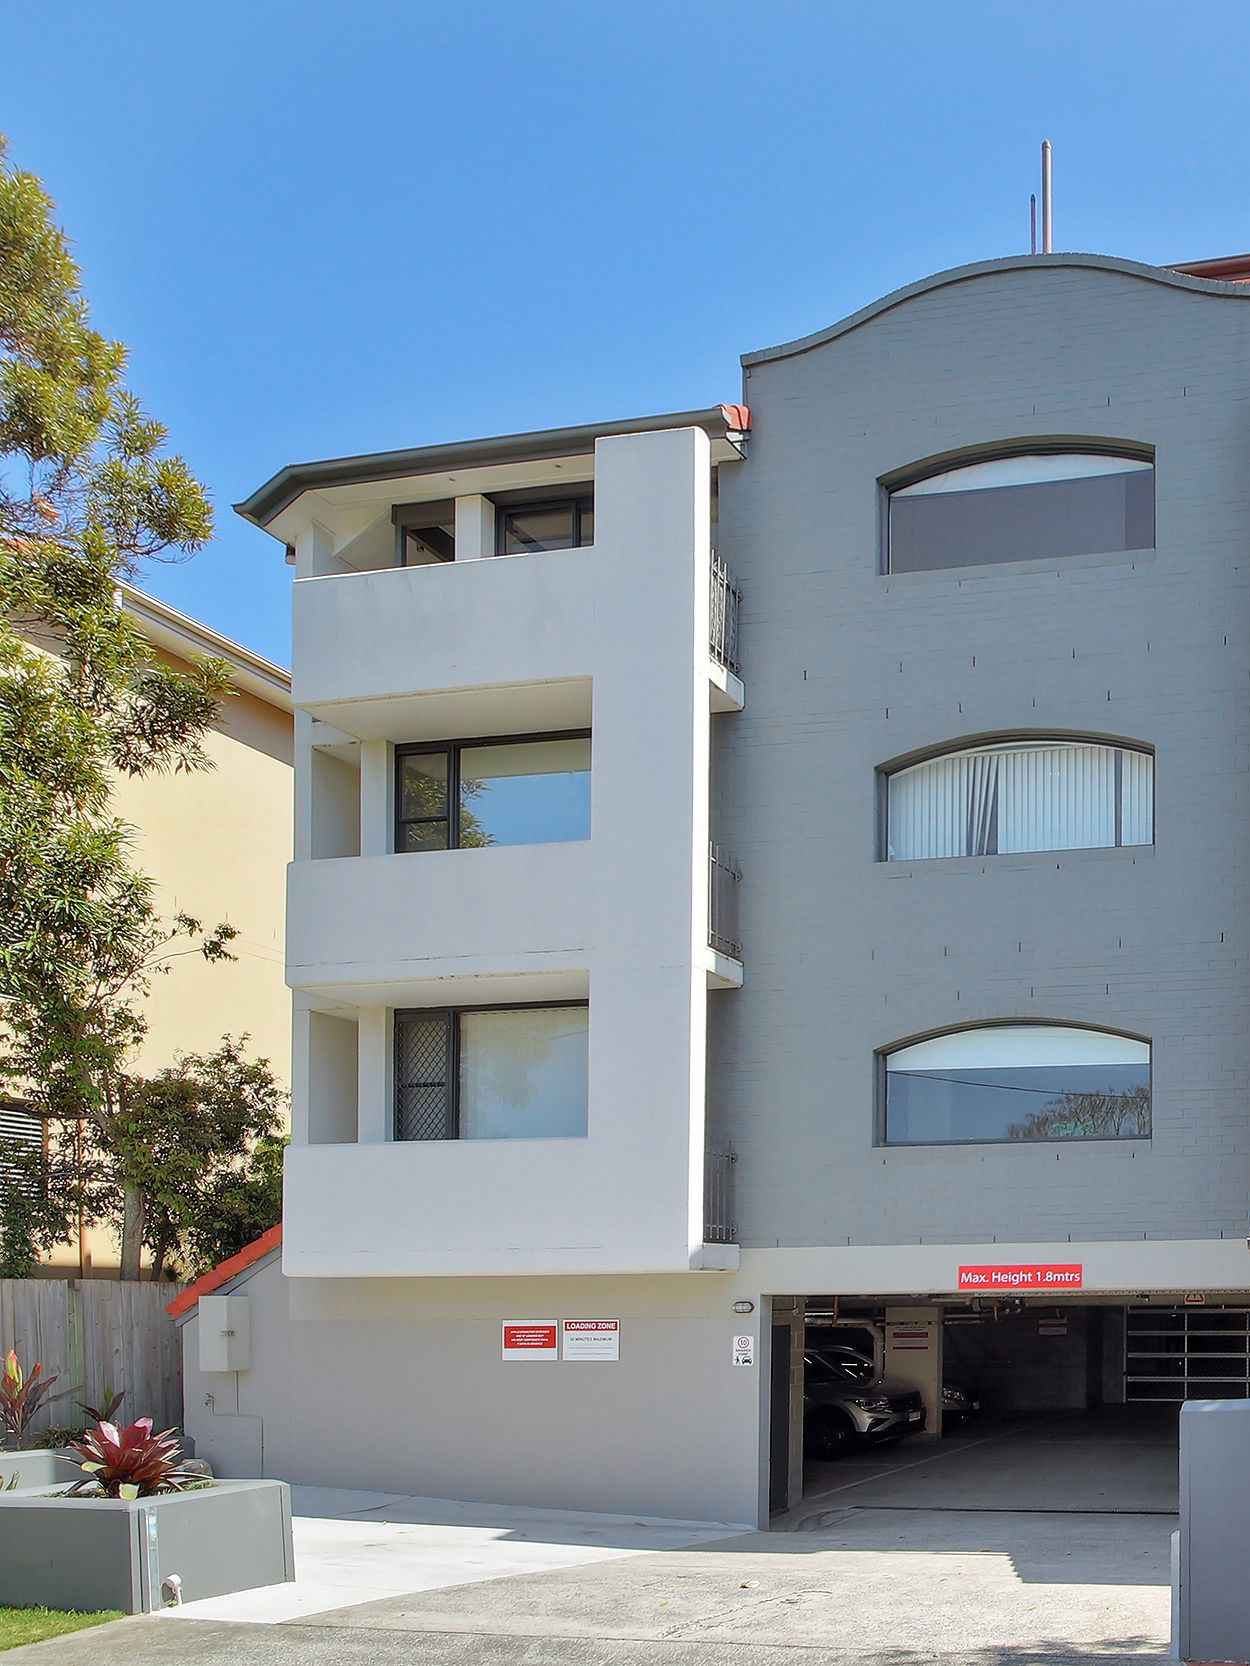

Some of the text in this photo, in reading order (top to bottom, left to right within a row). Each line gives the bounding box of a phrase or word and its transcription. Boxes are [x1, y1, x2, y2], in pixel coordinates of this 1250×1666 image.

[960, 1270, 1081, 1285] Max. Height 1.8mtrs
[566, 1322, 616, 1330] LOADING ZONE
